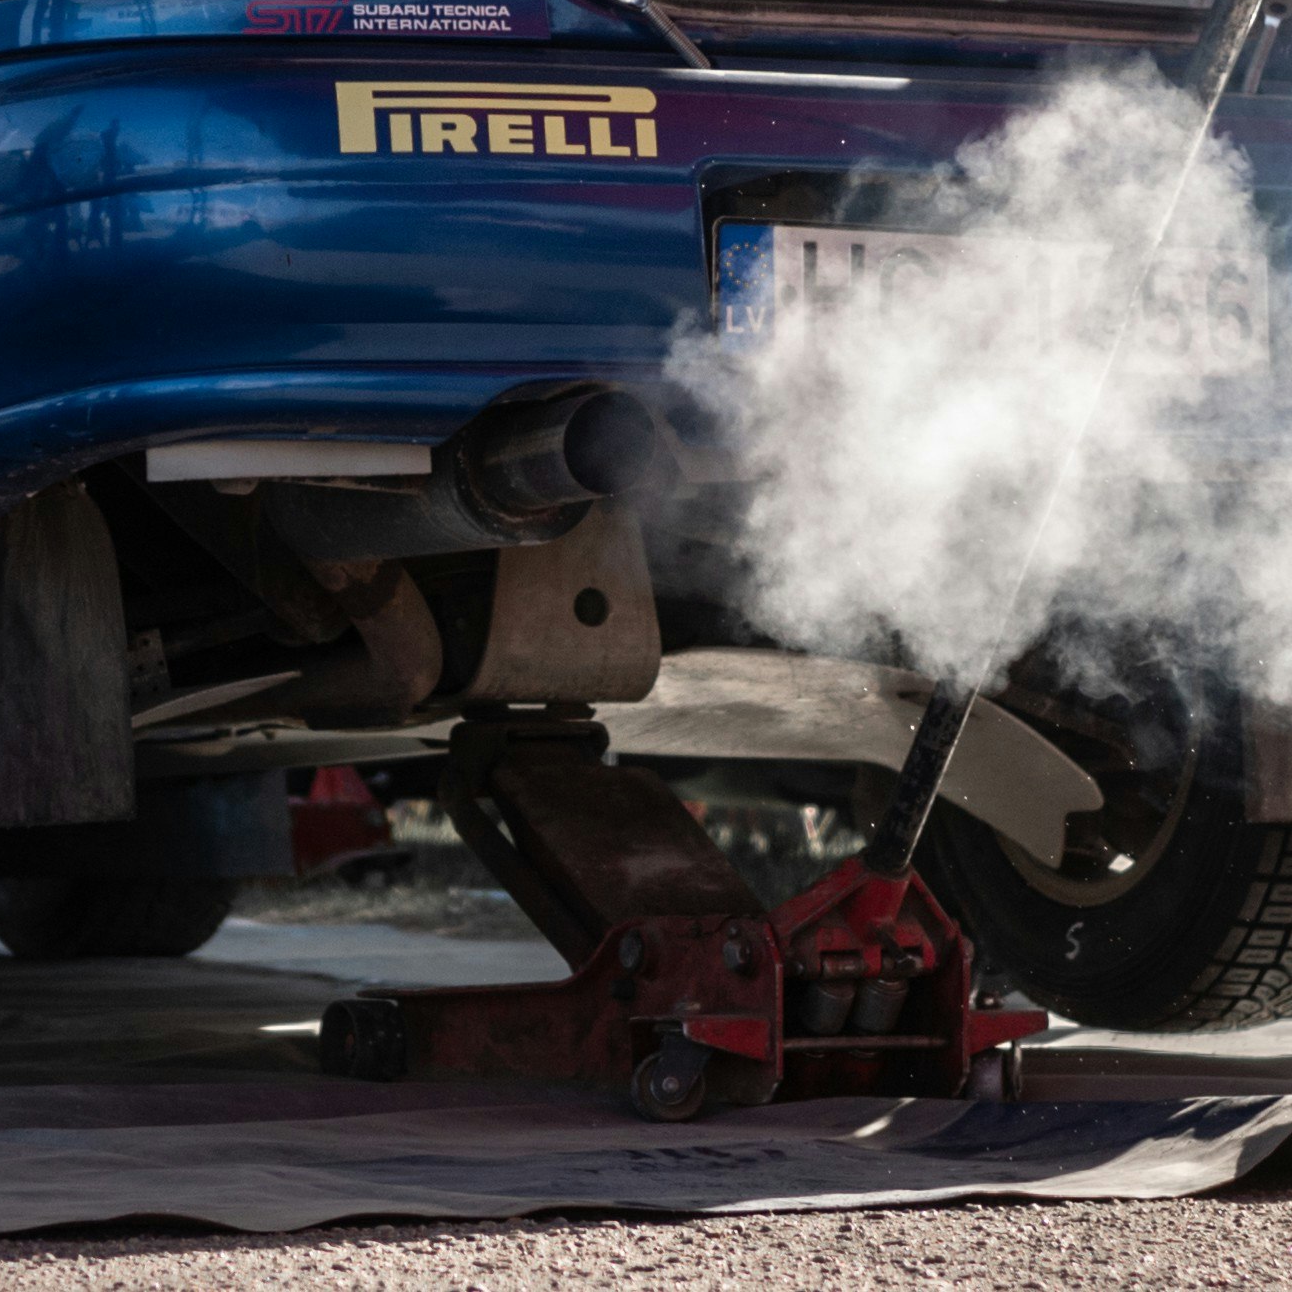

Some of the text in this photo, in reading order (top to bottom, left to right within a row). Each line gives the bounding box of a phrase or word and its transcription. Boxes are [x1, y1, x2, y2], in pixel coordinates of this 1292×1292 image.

[352, 4, 430, 17] SUBARU
[432, 4, 511, 18] TECNICA
[353, 18, 512, 32] INTERNATIONAL
[335, 81, 658, 158] PIRELLI
[725, 306, 766, 334] LV
